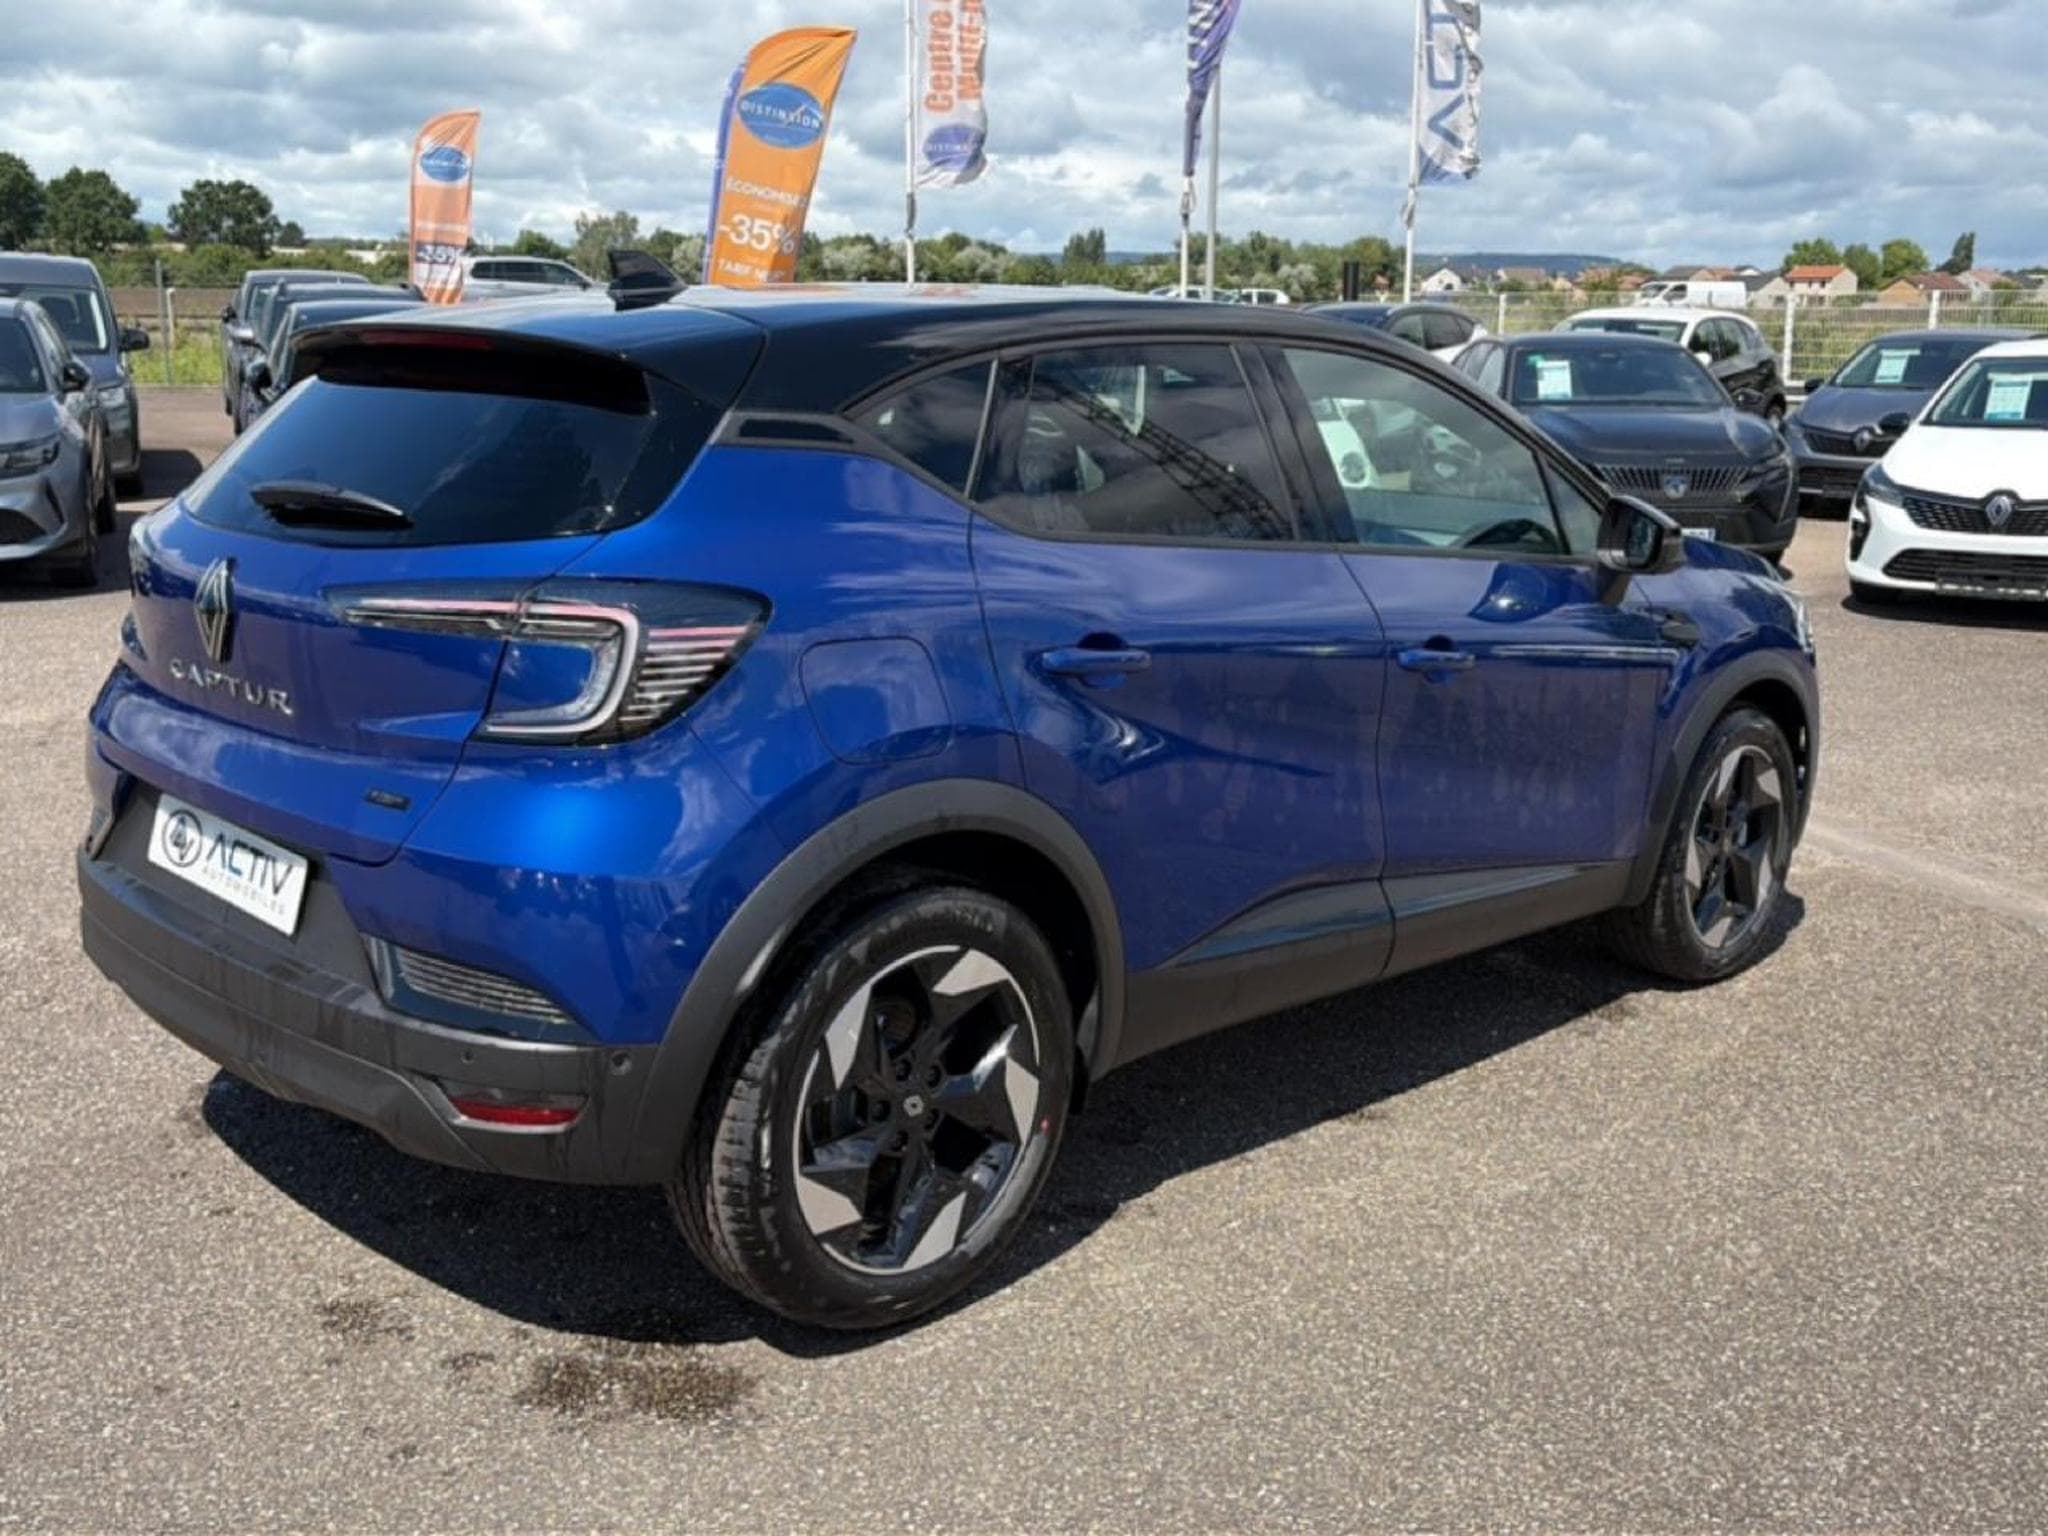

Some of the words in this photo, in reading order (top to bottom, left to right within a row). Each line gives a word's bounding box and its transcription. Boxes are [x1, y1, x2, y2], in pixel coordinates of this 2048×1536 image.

[925, 10, 953, 112] Centre
[719, 213, 795, 255] -35%
[169, 658, 294, 716] CAPTUR
[206, 833, 293, 896] ACTIV
